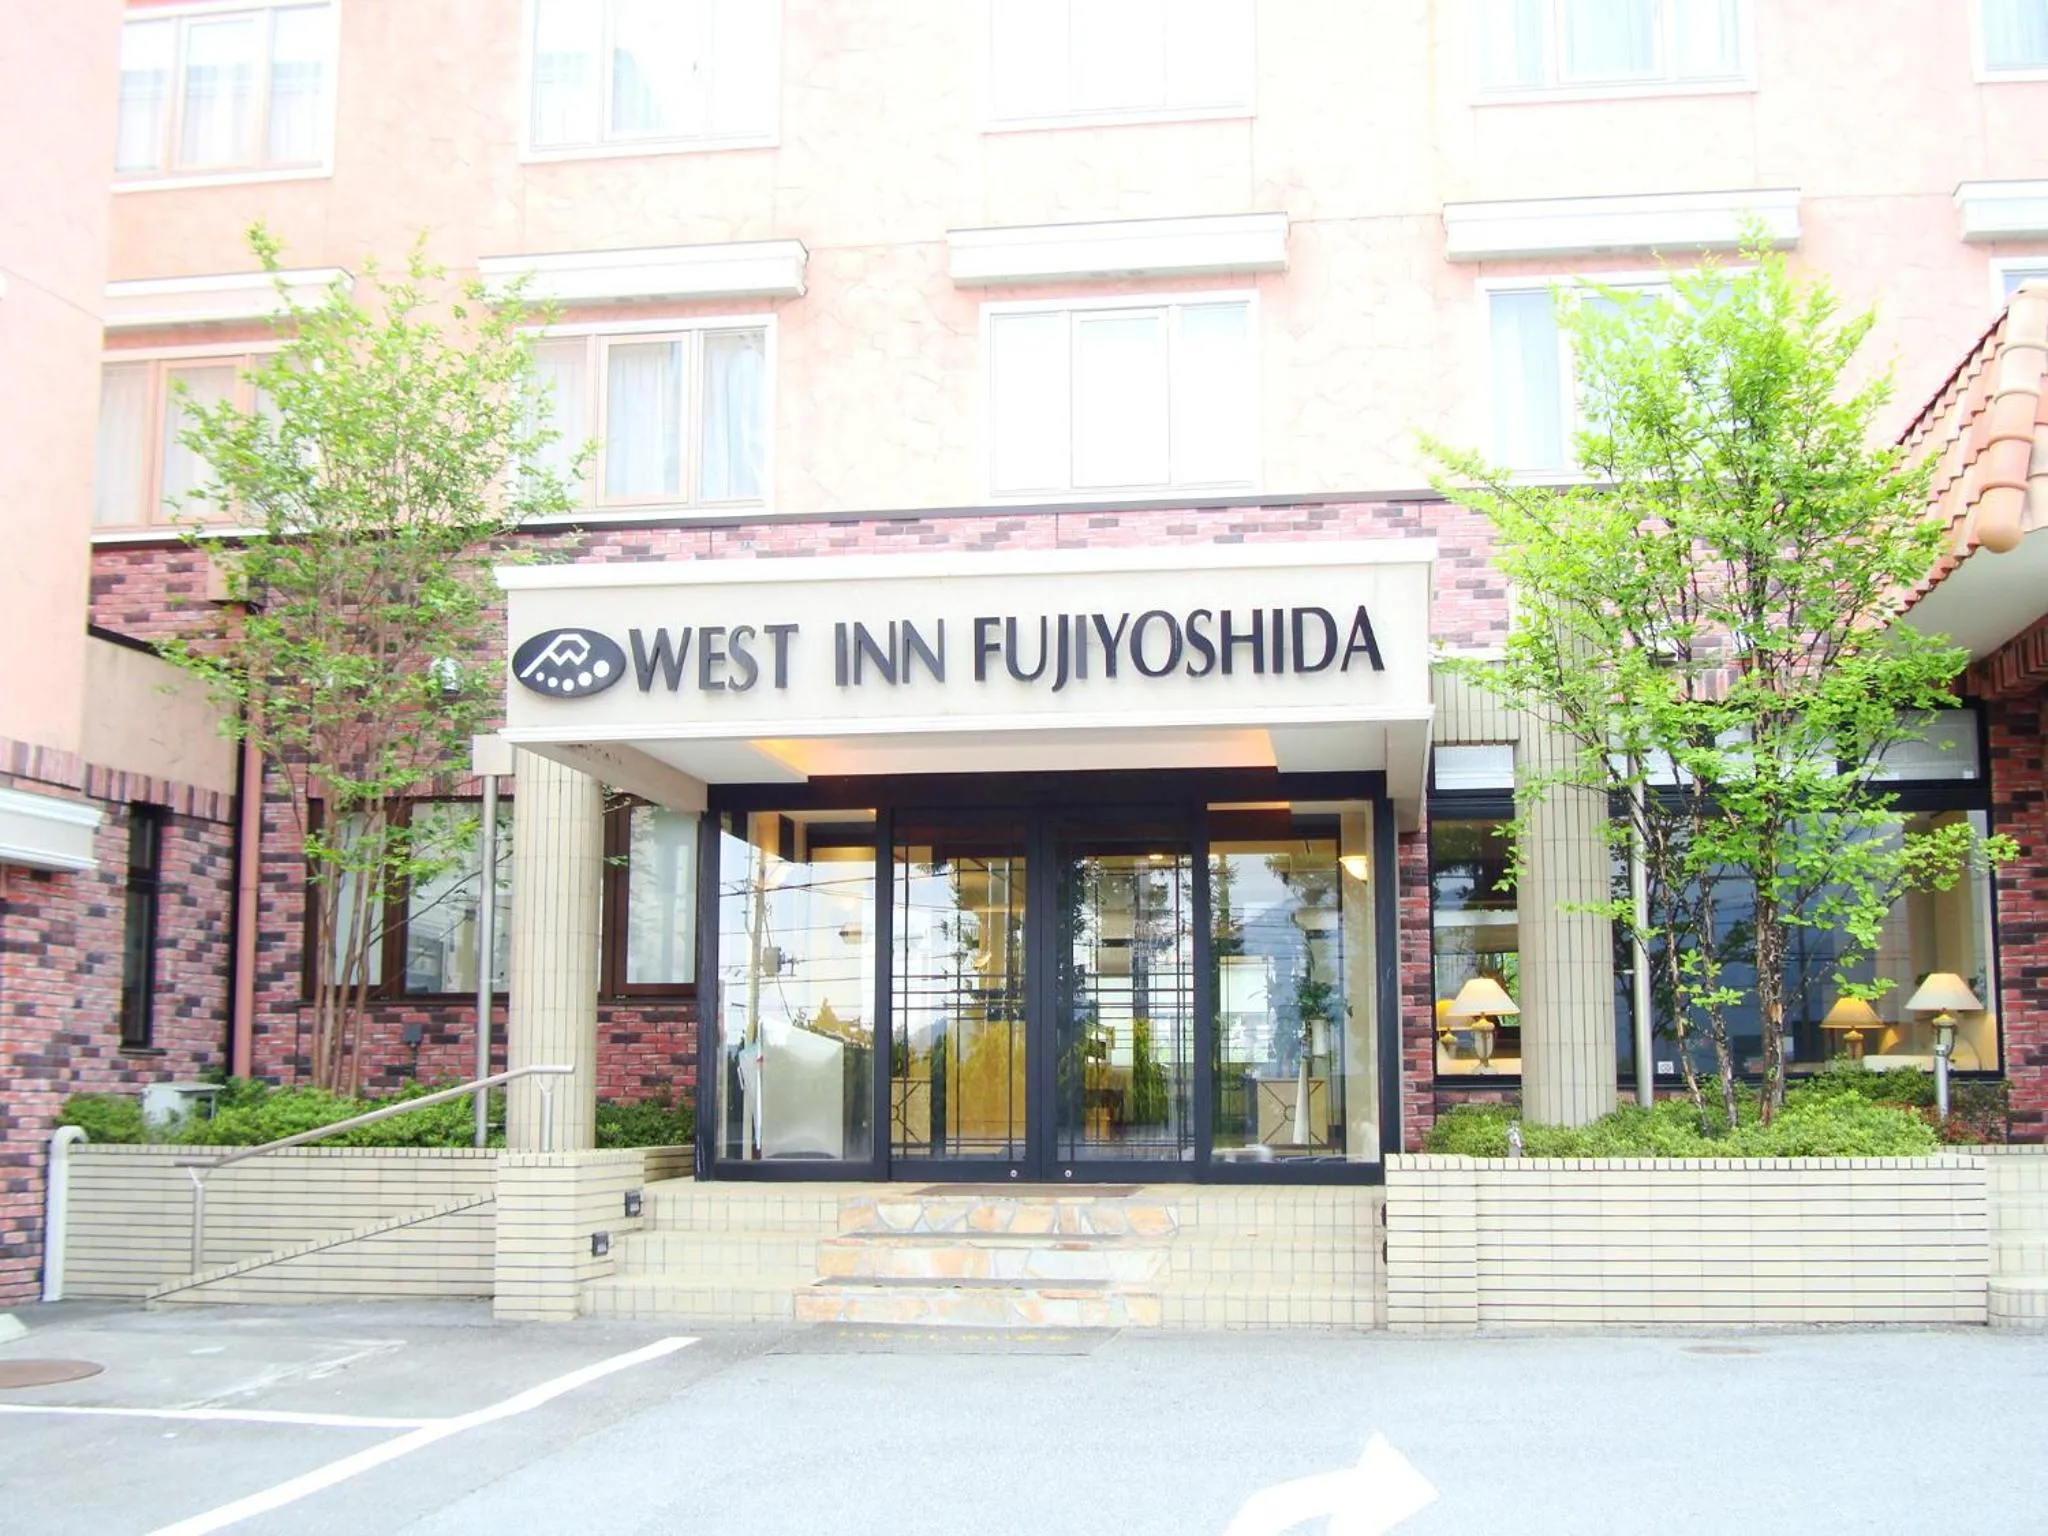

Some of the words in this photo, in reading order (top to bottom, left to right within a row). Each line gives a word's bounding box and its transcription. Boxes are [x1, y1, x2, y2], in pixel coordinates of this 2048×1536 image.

[628, 623, 799, 693] WEST
[834, 618, 945, 686] INN
[973, 605, 1385, 693] FUJIYOSHIDA
